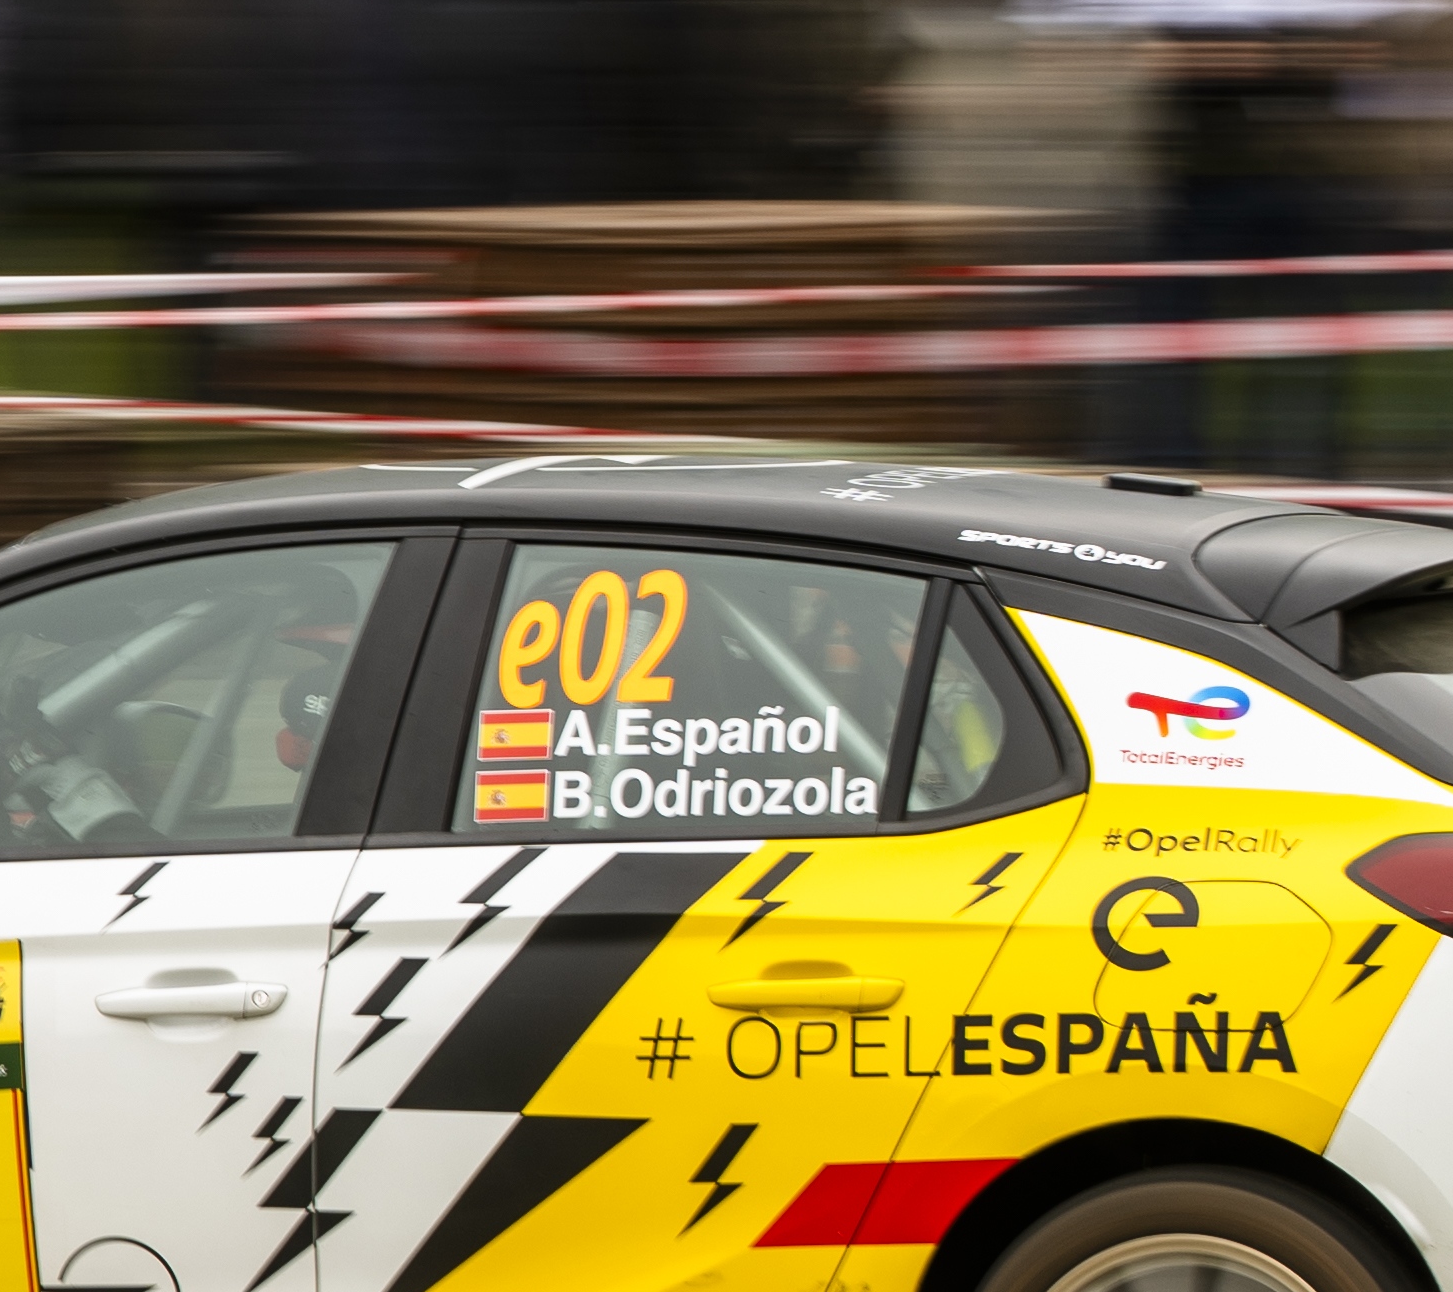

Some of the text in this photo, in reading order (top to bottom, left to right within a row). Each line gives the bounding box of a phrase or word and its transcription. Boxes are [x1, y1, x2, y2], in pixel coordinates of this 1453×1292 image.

[498, 570, 688, 708] e02
[554, 706, 840, 767] A.Español
[1120, 750, 1245, 770] TotalEnergies
[553, 767, 878, 818] B.Odriozola
[1103, 827, 1300, 858] #OpelRally
